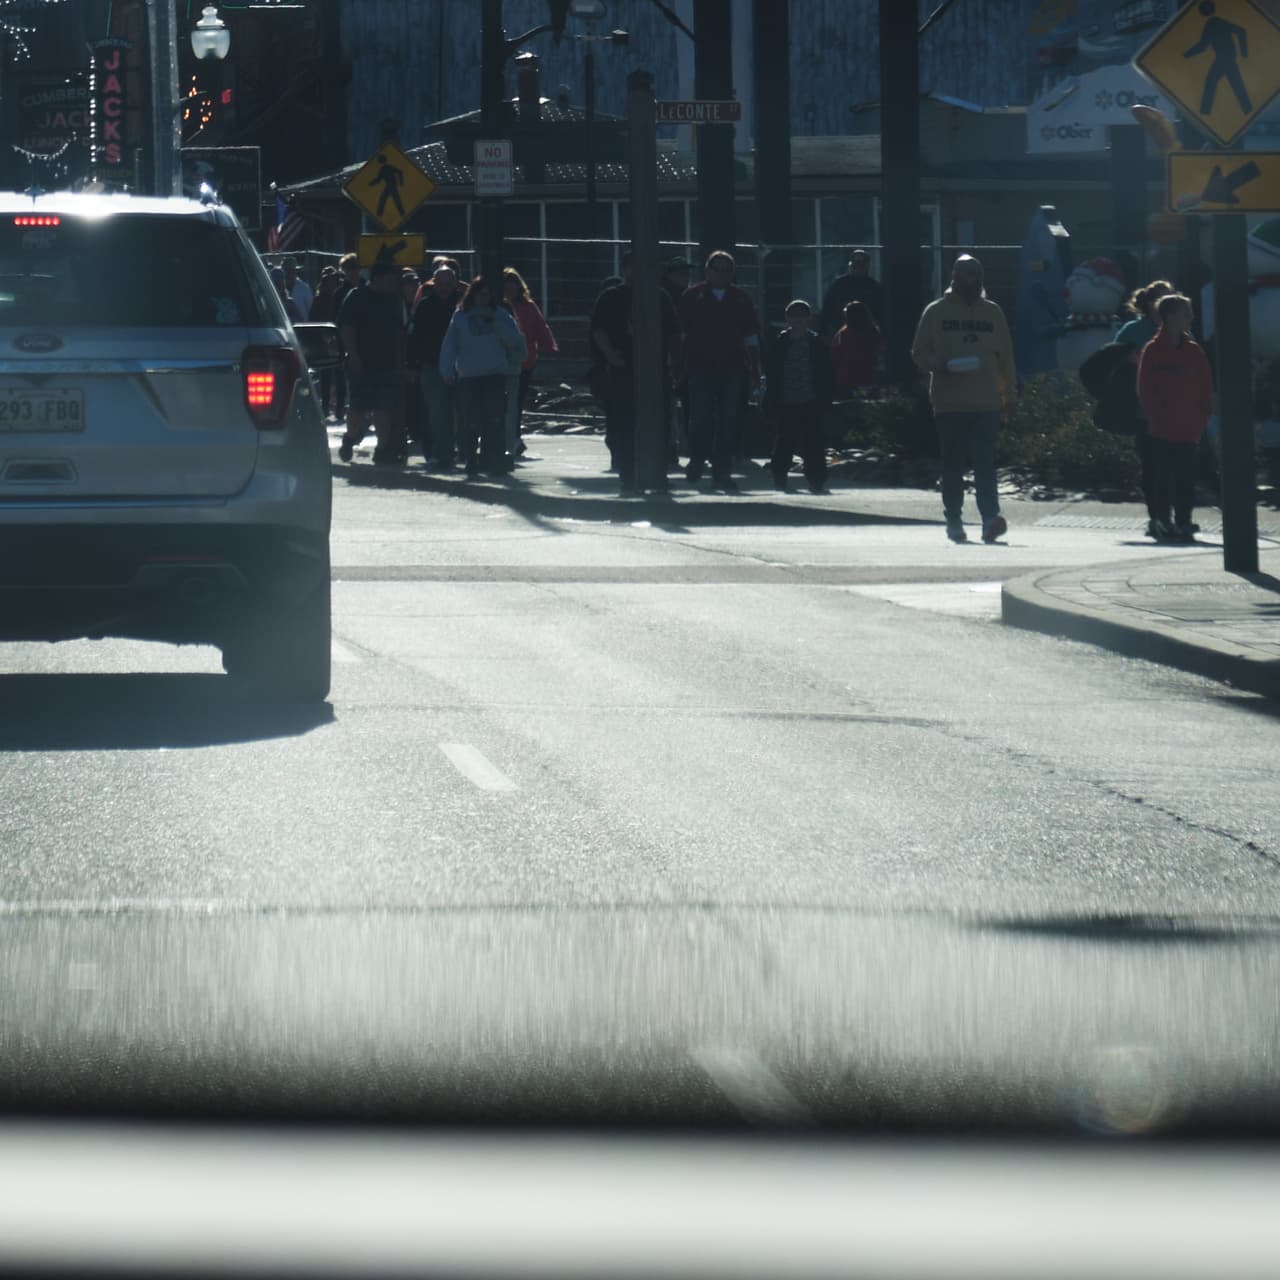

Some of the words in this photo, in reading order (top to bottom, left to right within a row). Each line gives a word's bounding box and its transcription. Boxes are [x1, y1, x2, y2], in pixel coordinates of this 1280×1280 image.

[102, 50, 121, 164] JACKS
[1055, 122, 1094, 140] Ober
[485, 147, 502, 158] NO
